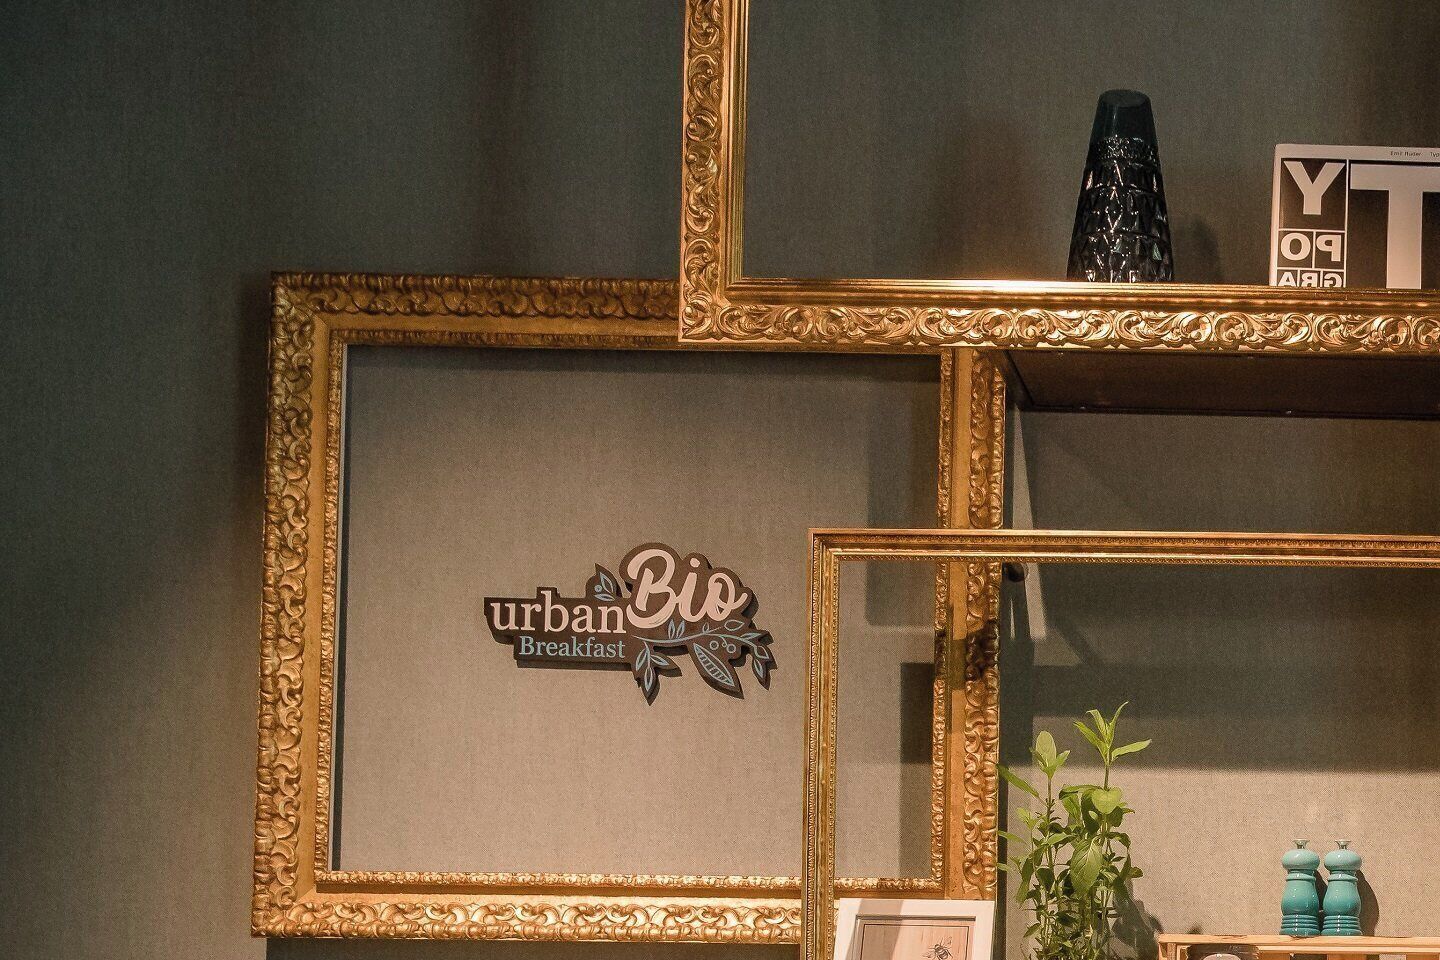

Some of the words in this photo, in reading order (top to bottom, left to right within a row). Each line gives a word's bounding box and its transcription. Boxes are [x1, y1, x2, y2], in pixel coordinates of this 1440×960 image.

[489, 590, 627, 634] urban
[626, 548, 748, 629] Bio
[518, 636, 626, 659] Breakfast
